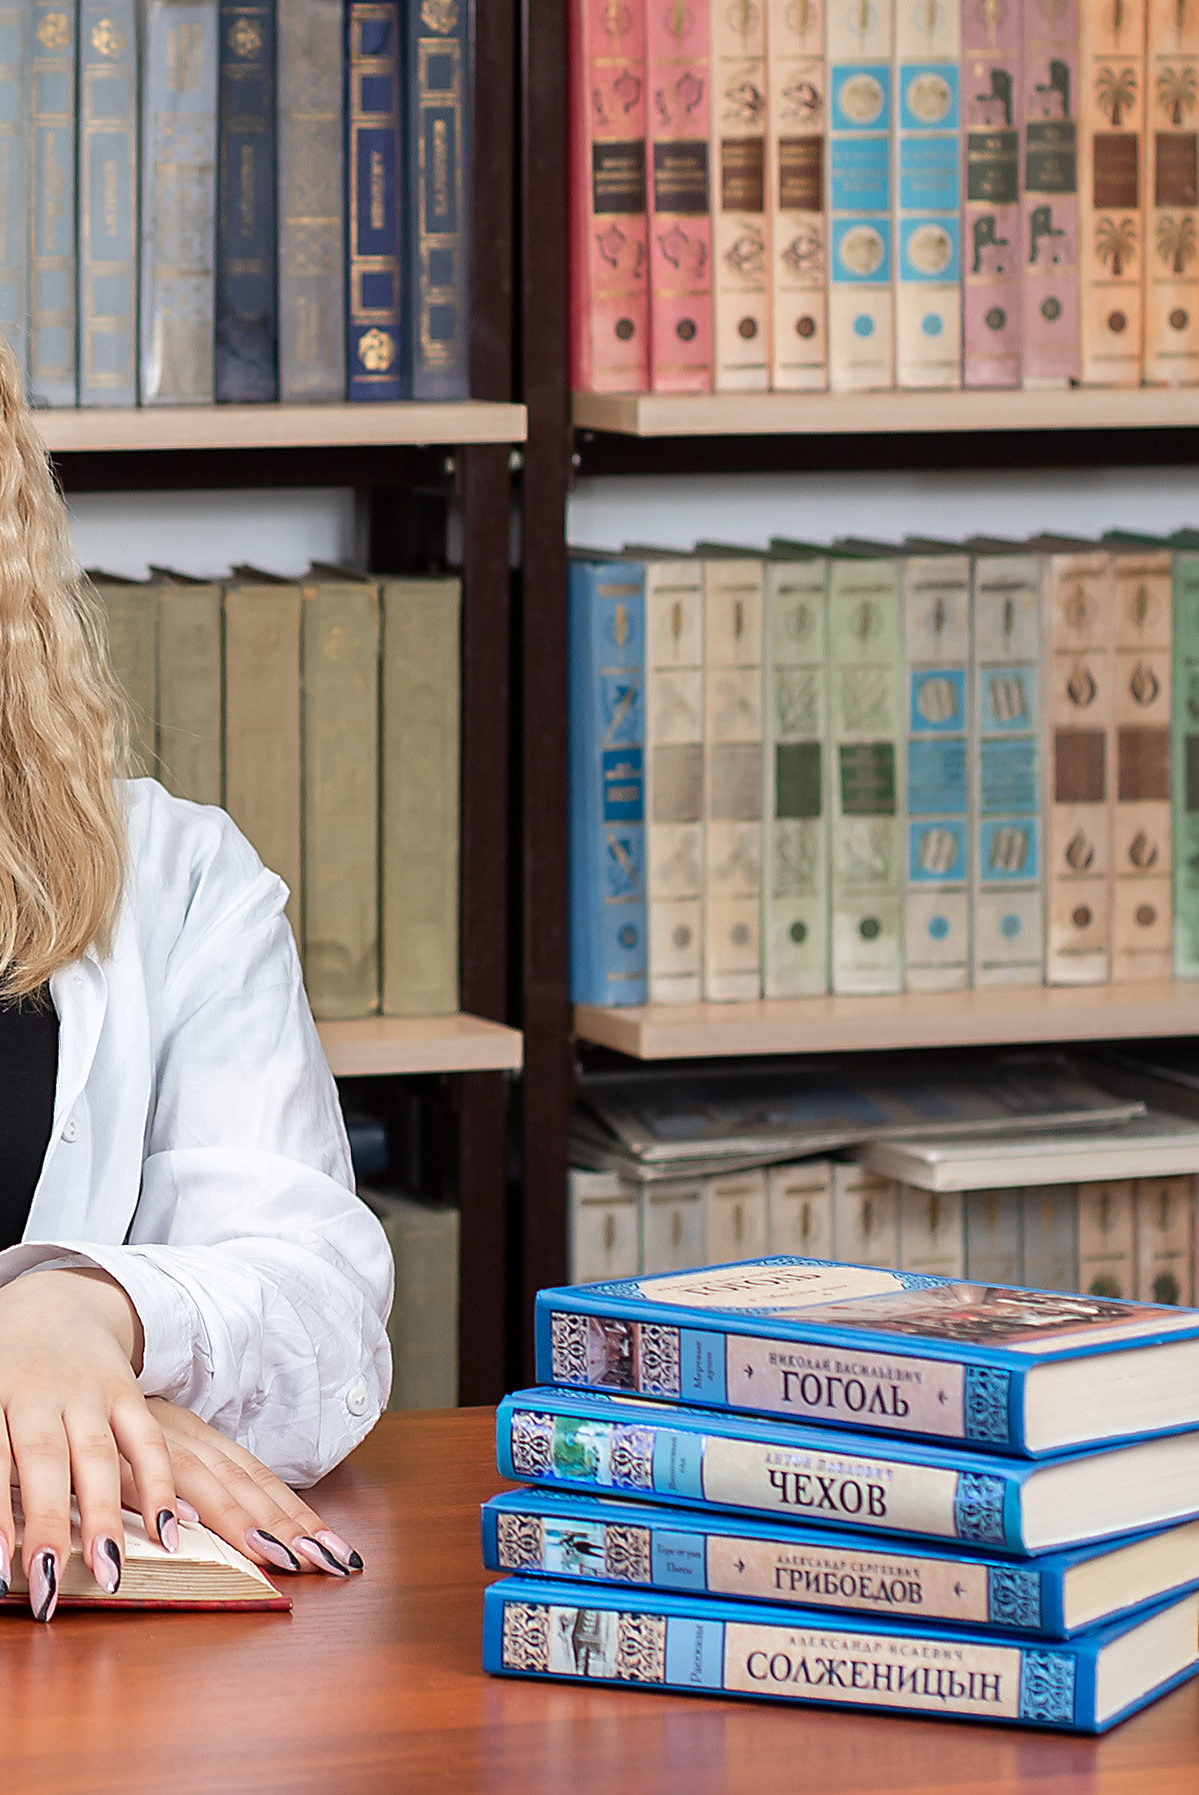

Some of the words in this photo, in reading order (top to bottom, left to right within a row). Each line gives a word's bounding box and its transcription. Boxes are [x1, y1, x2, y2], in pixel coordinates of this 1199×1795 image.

[768, 1352, 832, 1372] НИКОЛАЙ
[834, 1361, 923, 1384] ВАСИЛЬЕВИЧ
[781, 1370, 910, 1418] ГОГОЛЬ
[764, 1452, 813, 1470] АНТОН
[767, 1469, 887, 1518] ЧЕХОВ
[776, 1554, 847, 1572] АЛЕКСАНДР
[850, 1561, 921, 1579] СЕРГЕЕВИЧ
[774, 1567, 924, 1605] ГРИБОЕДОВ
[788, 1635, 883, 1653] АЛЕКСАНДР
[888, 1642, 964, 1661] ИСАЕВИЧ
[746, 1651, 1003, 1703] СОЛЖЕНИЦЫН
